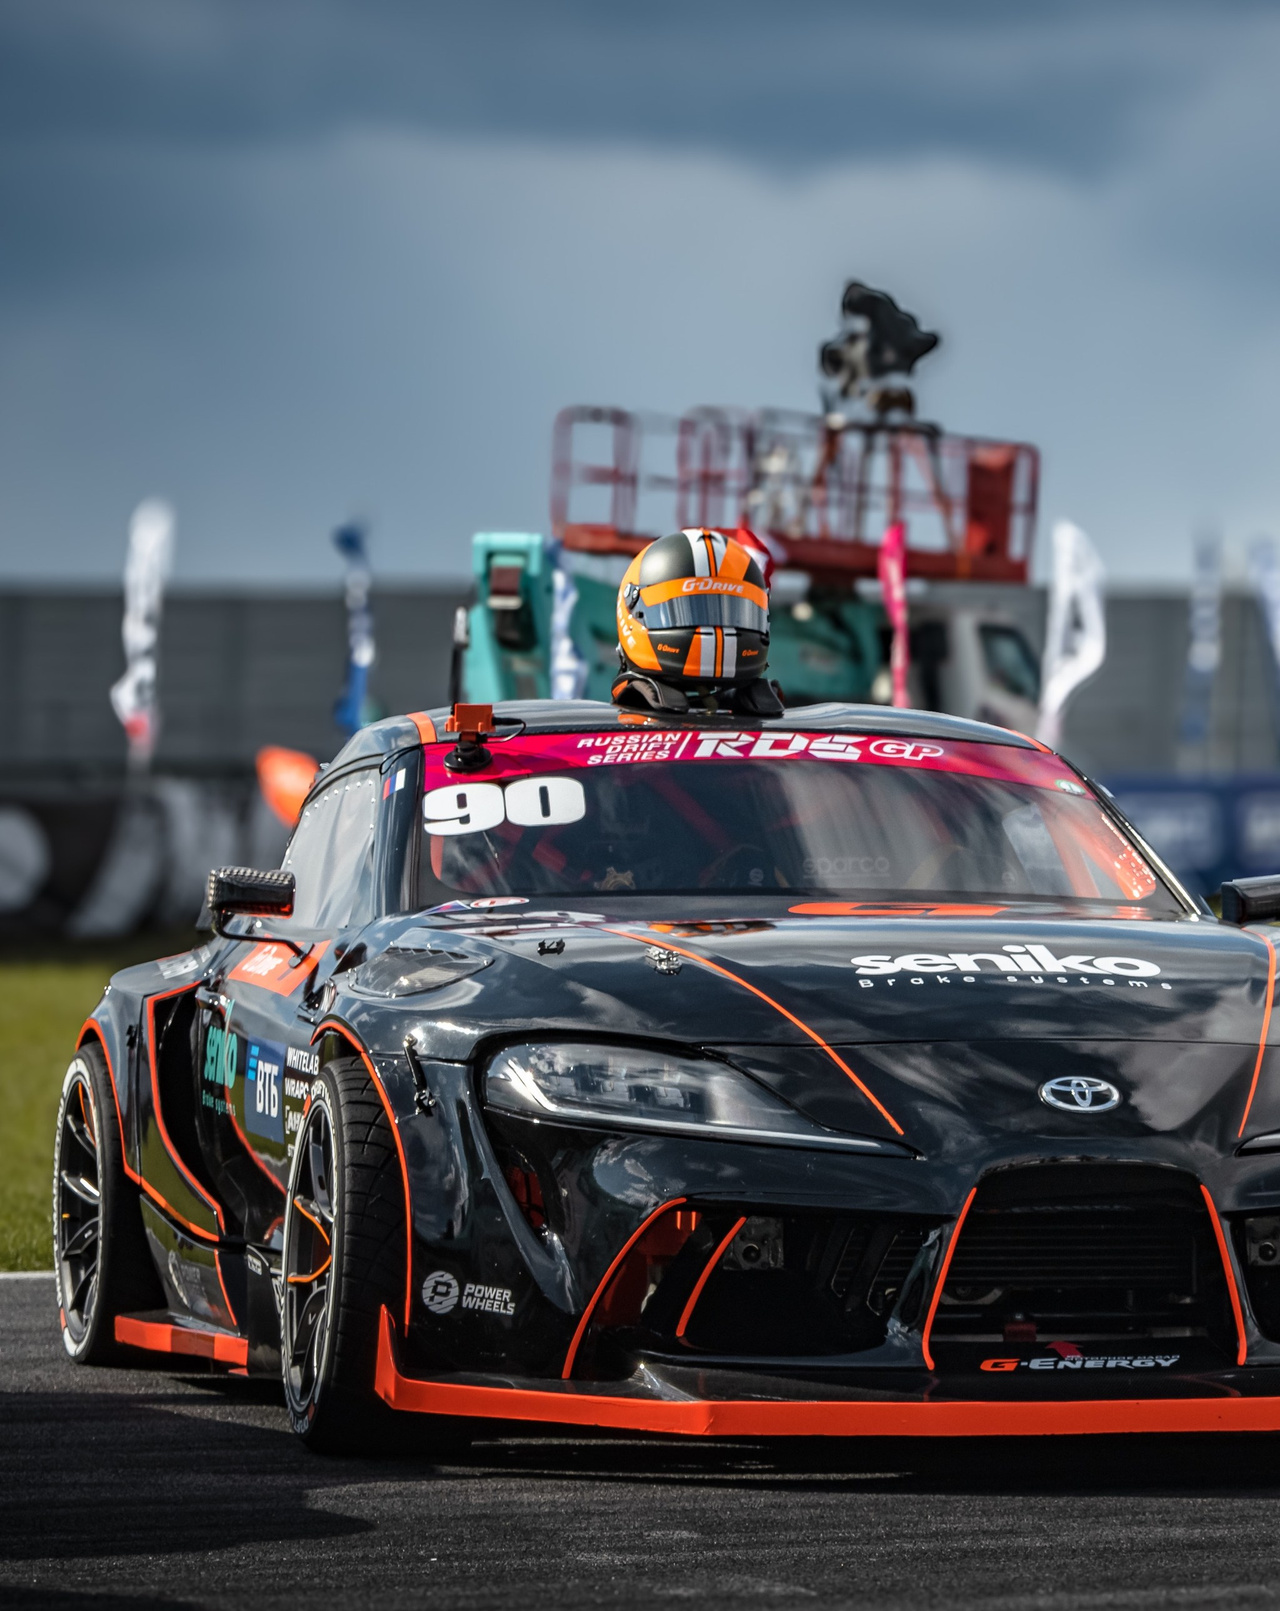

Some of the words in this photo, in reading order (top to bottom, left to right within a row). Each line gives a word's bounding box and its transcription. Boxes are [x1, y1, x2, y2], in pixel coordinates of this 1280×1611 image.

[577, 732, 681, 749] RUSSIAN
[604, 741, 673, 755] DRIFT
[693, 733, 867, 761] RDS
[869, 740, 944, 761] GP
[586, 750, 670, 765] SERIES
[421, 776, 586, 836] 90
[850, 944, 1161, 978] seniko
[858, 975, 976, 988] Brake
[1006, 975, 1172, 989] systems
[286, 1046, 319, 1075] WHITELAB
[256, 1060, 278, 1118] ВТБ
[463, 1283, 512, 1302] POWER
[461, 1296, 516, 1316] WHEELS
[980, 1358, 1179, 1371] G-ENERGY
